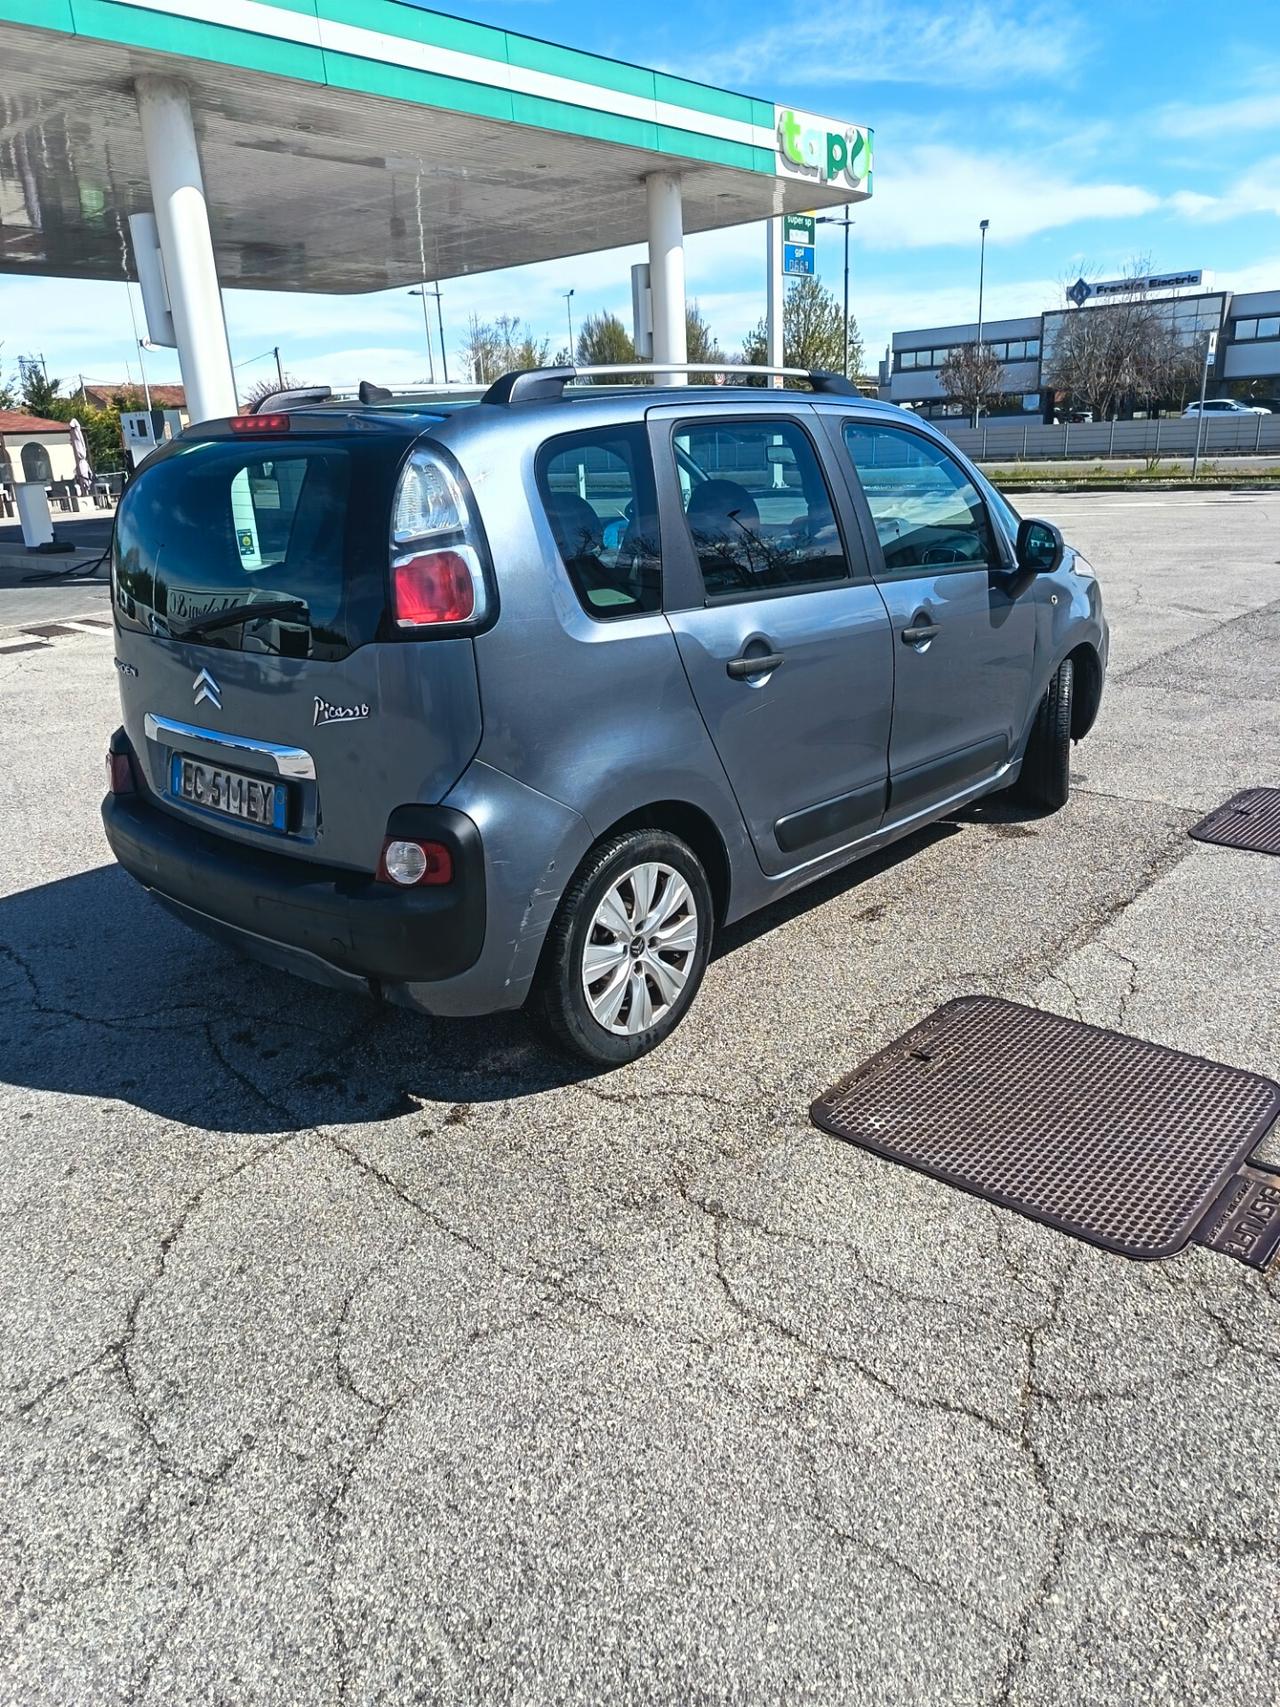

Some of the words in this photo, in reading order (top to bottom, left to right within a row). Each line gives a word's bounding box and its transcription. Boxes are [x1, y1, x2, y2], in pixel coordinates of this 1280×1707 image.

[787, 215, 804, 226] super
[804, 218, 812, 228] sp
[1096, 280, 1145, 295] Franklin
[1148, 274, 1199, 288] Electric
[313, 695, 369, 726] Picasso
[183, 762, 205, 799] EC
[211, 771, 272, 821] 511EY
